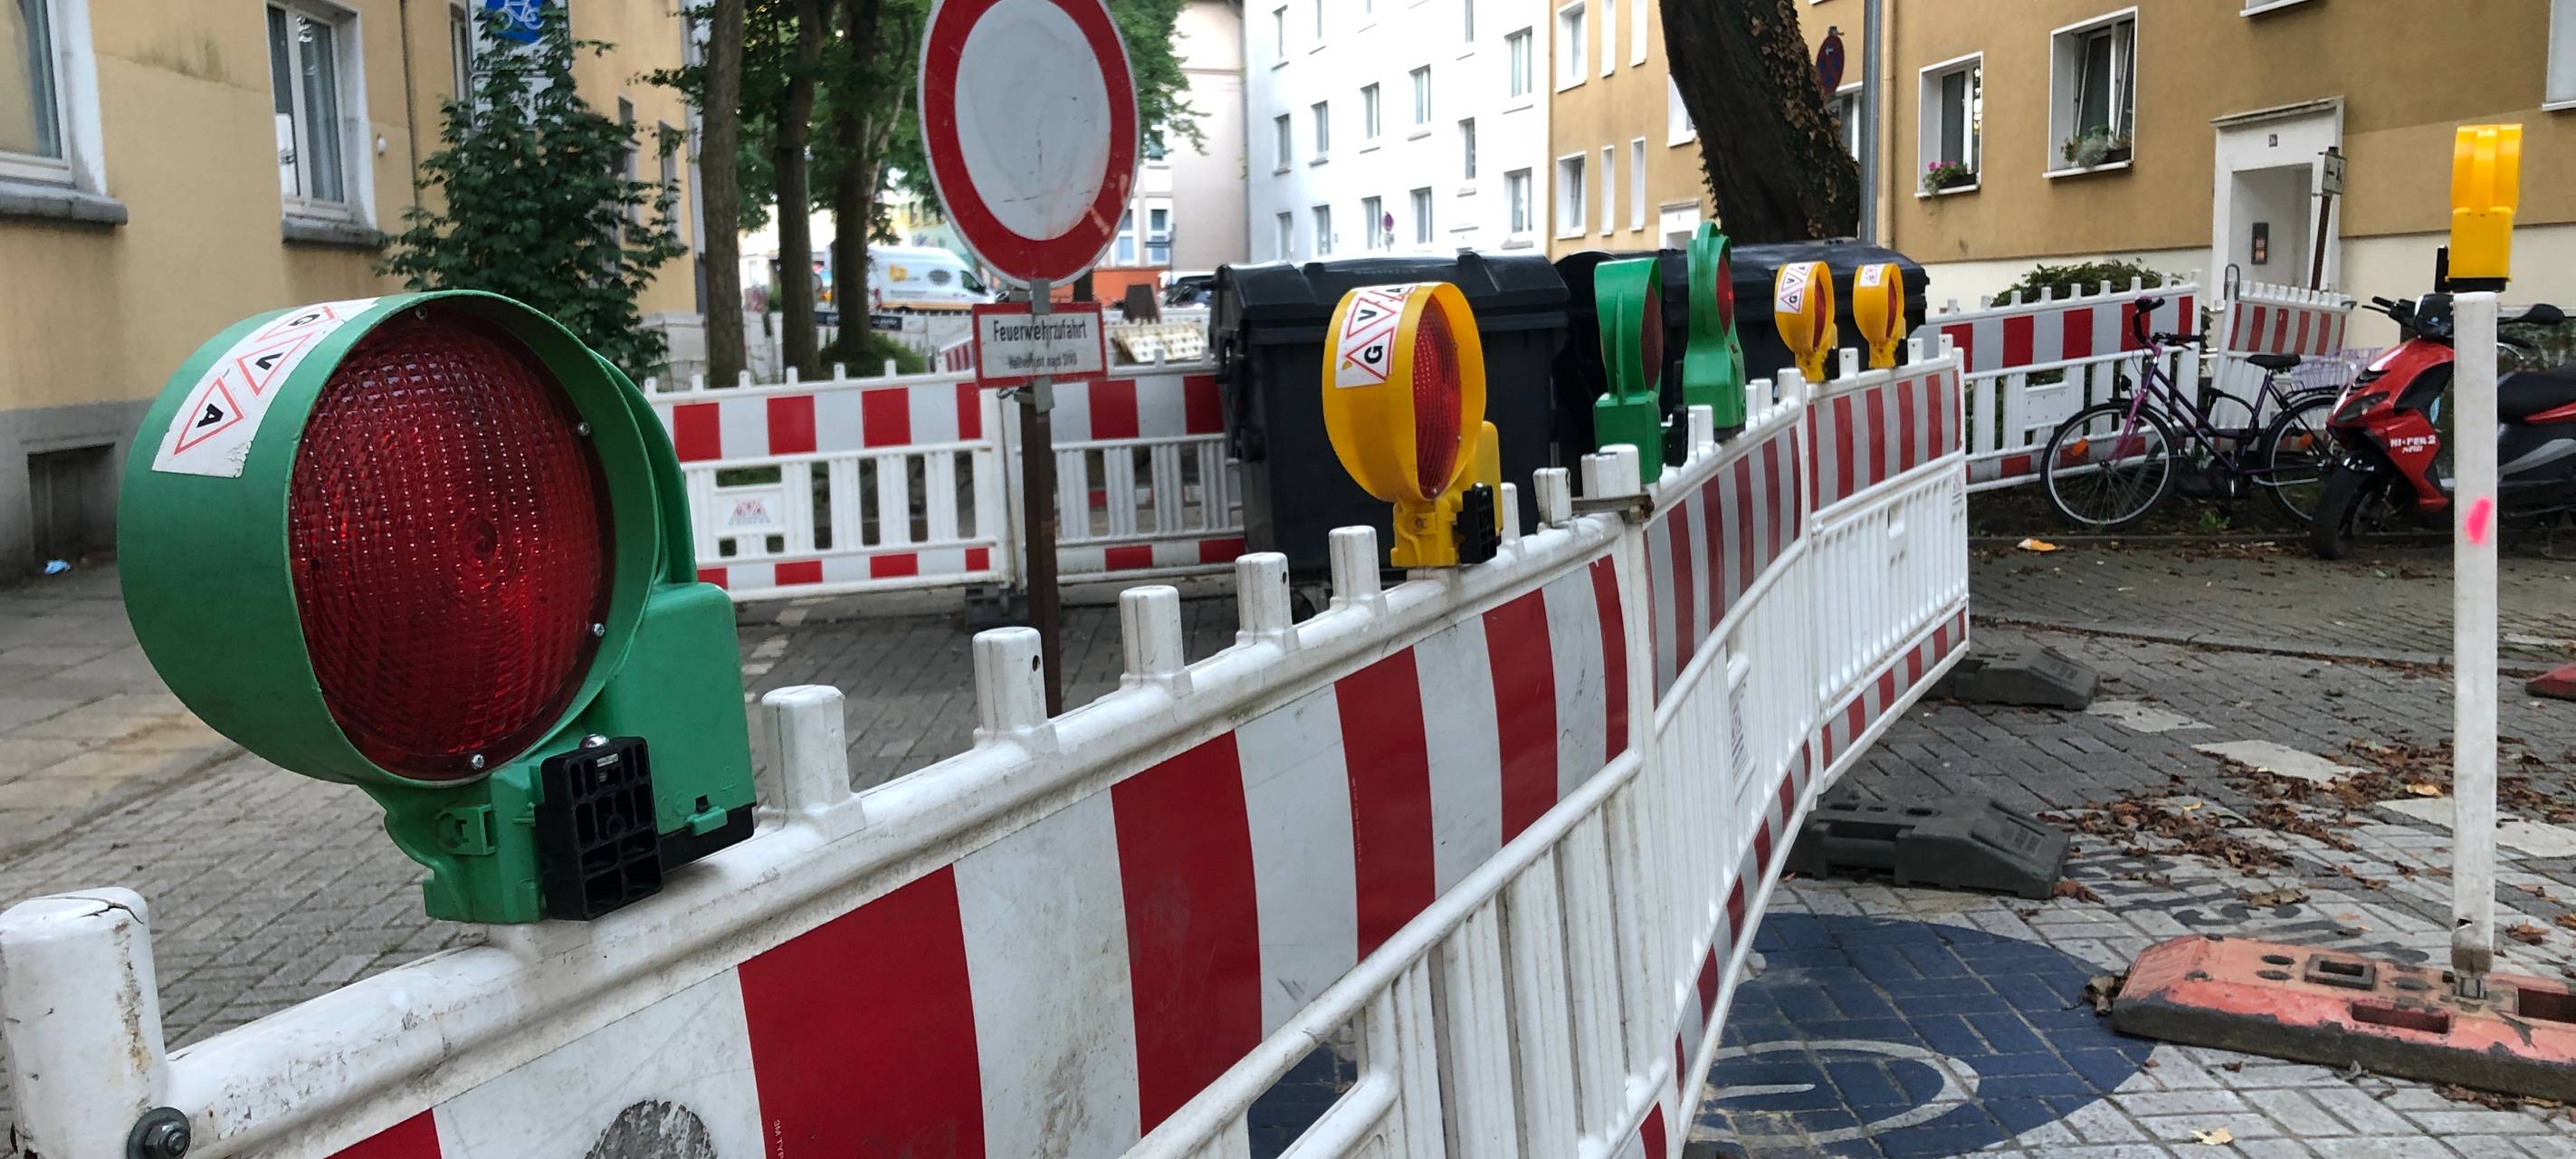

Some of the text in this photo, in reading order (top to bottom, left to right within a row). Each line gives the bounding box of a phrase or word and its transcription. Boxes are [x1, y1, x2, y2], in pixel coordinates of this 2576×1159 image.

[1358, 309, 1377, 321] V
[993, 318, 1088, 342] Feuerwehrzufahrt
[1364, 345, 1383, 364] G
[196, 313, 320, 428] G V A
